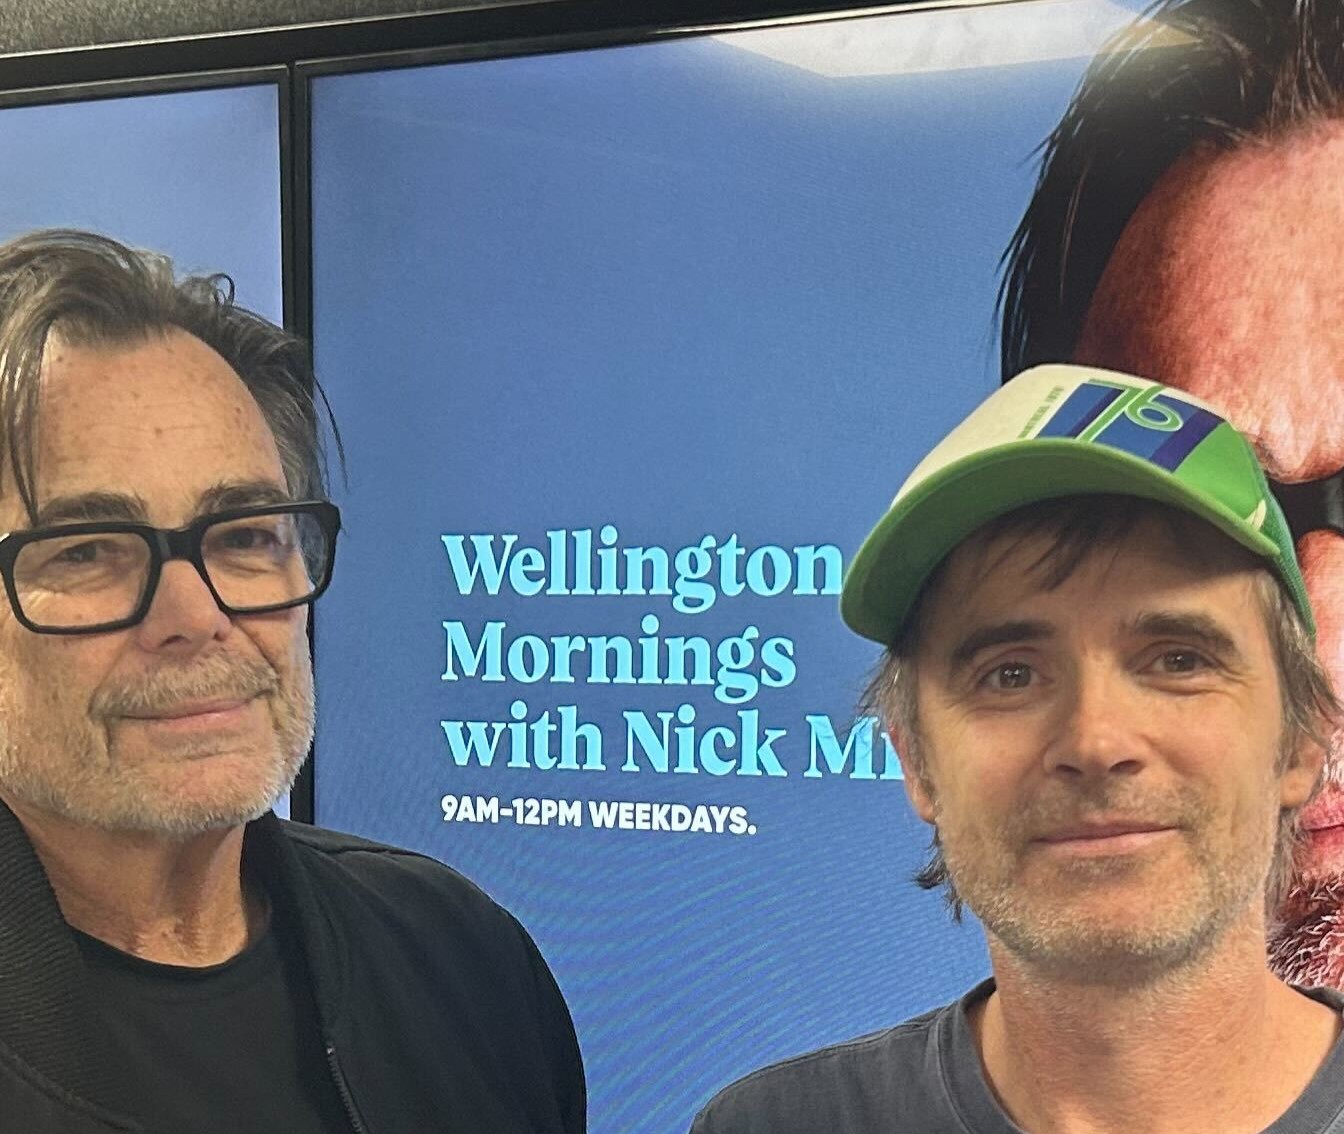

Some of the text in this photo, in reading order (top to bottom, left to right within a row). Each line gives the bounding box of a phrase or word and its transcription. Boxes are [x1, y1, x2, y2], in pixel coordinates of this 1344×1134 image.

[442, 525, 843, 614] Wellington
[442, 614, 796, 704] Mornings
[441, 700, 606, 770] with
[622, 704, 787, 776] Nick
[442, 795, 756, 835] 9AM-12PM WEEKDAYS.
